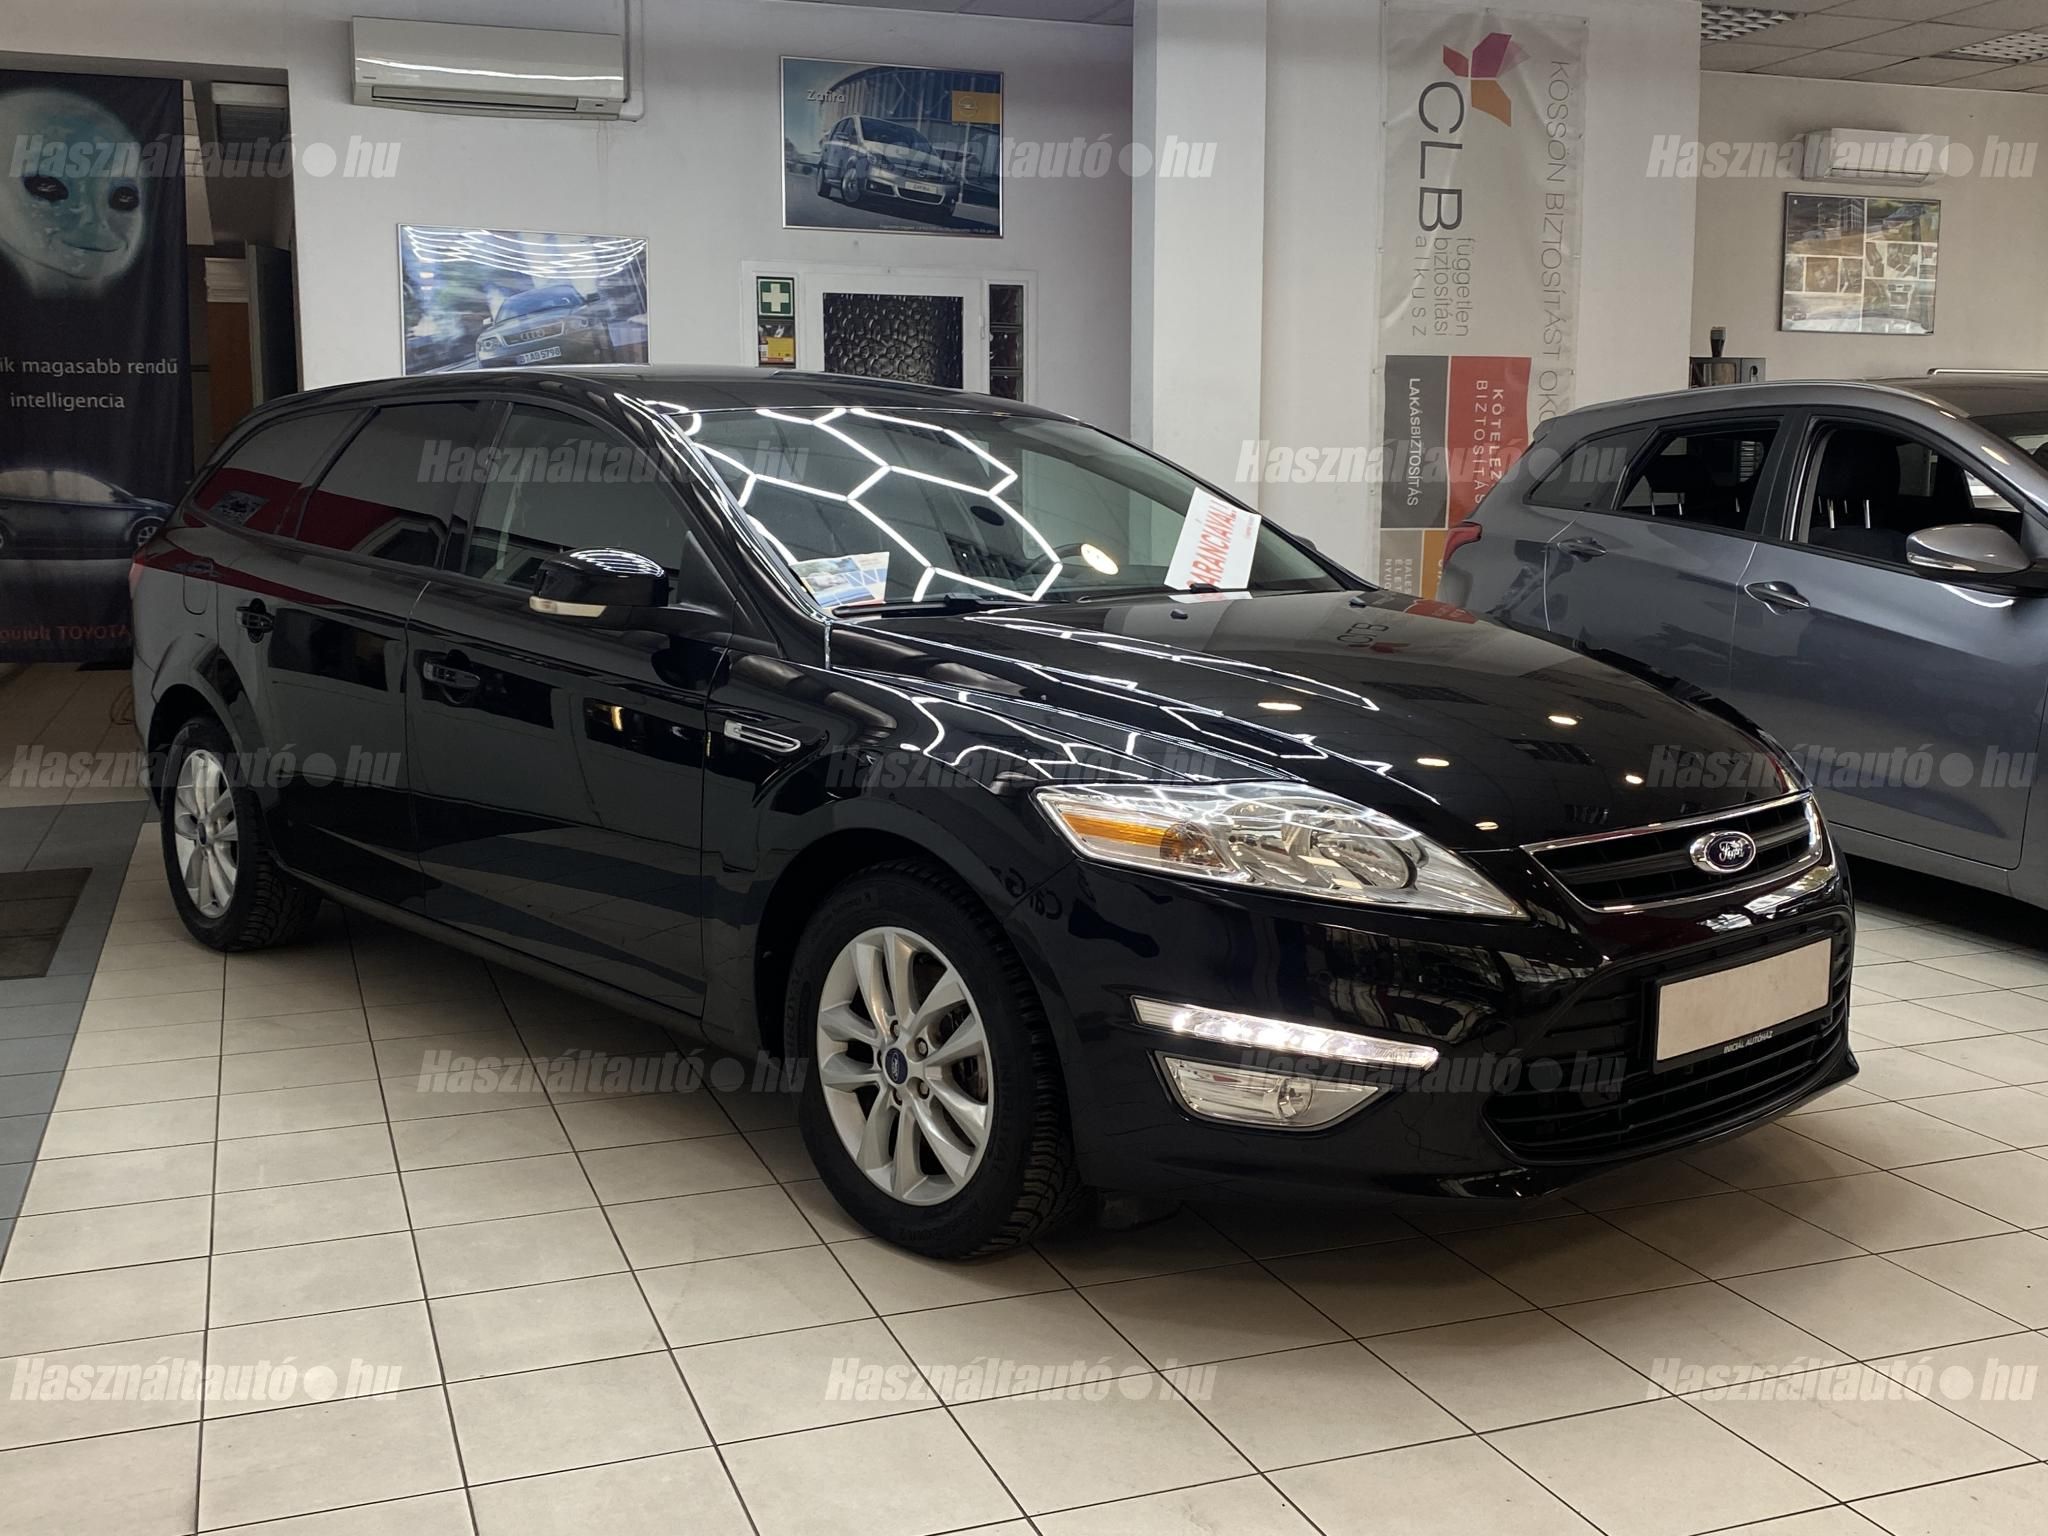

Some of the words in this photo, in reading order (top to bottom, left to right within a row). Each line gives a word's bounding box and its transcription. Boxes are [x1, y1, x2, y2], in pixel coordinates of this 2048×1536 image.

[1418, 81, 1464, 232] CLB
[1546, 61, 1574, 183] KÖSSÖN
[1433, 237, 1454, 336] biztosítási
[1452, 236, 1475, 337] független
[1541, 192, 1567, 361] BIZTOSÍTÁST
[10, 391, 126, 412] intelligencia
[22, 358, 121, 378] magasabb
[127, 358, 178, 374] rendű
[1407, 378, 1423, 506] LAKÁSBIZTOSÍTÁS
[56, 624, 129, 640] TOYOTA
